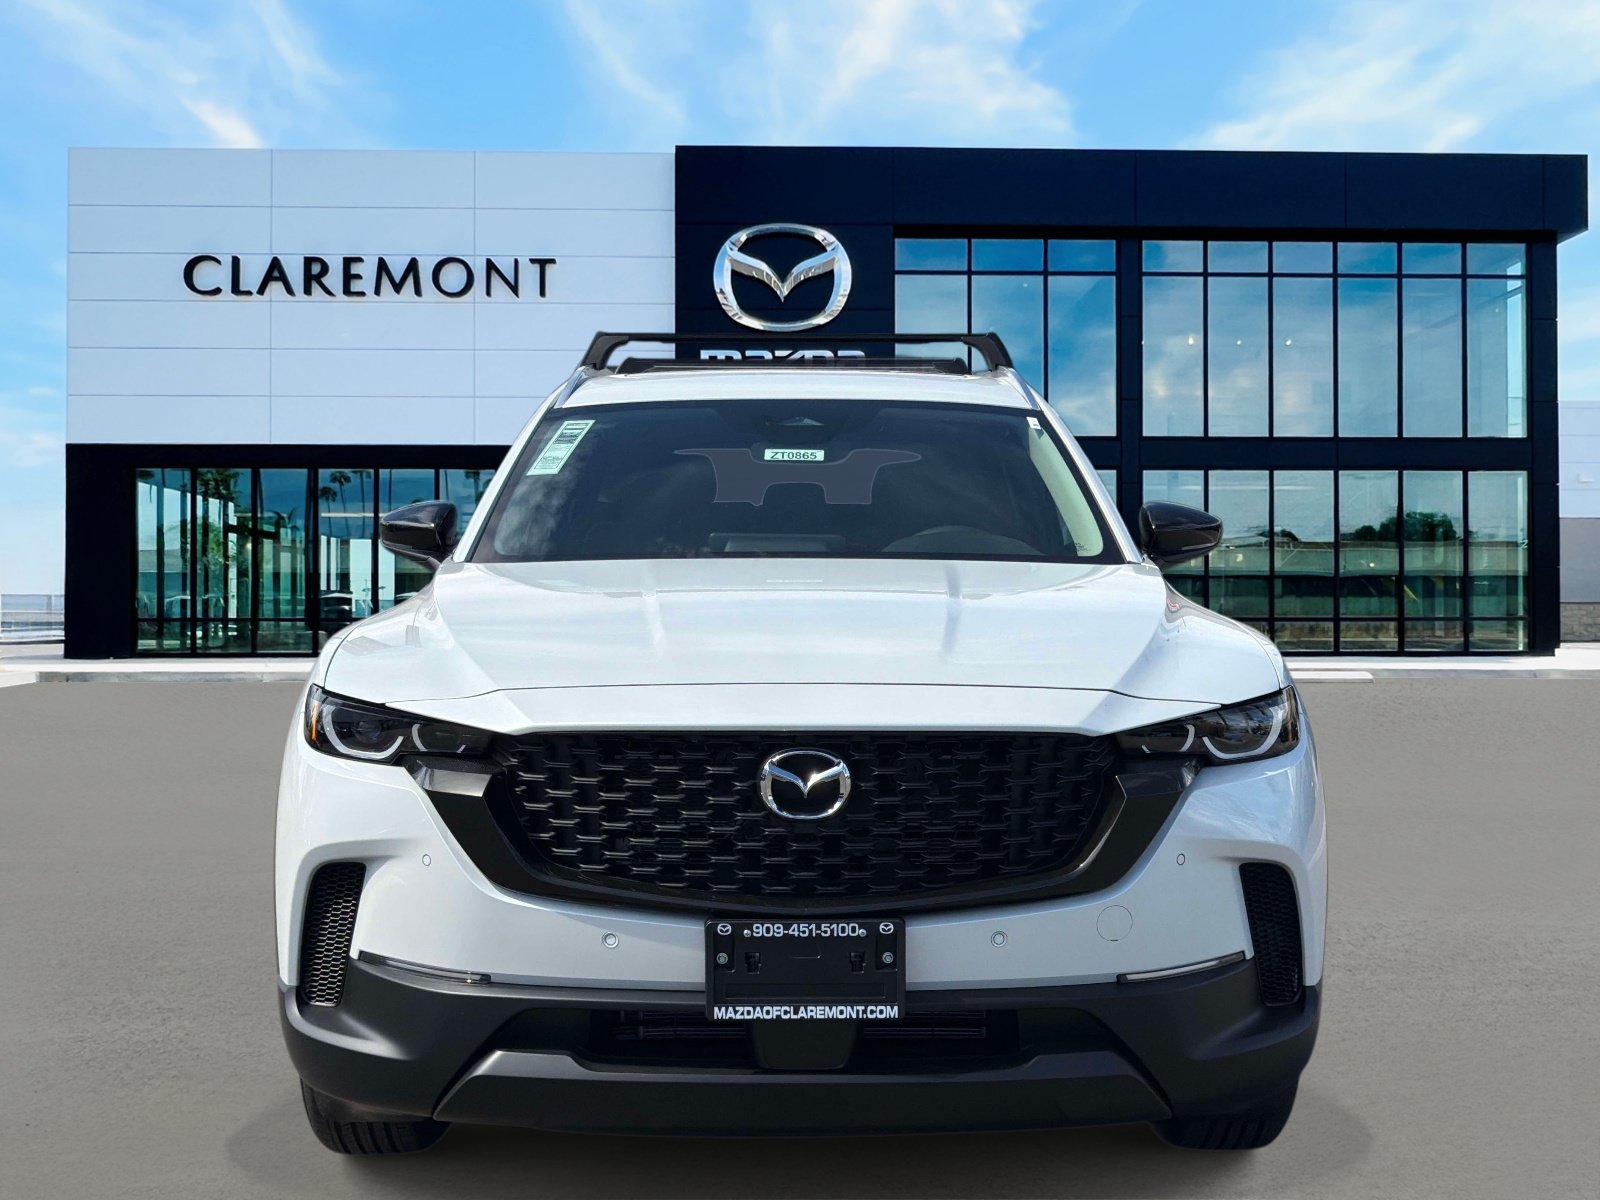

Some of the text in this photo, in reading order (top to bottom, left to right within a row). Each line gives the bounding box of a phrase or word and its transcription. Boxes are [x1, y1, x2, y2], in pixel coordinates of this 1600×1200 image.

[183, 254, 557, 298] CLAREMONT
[770, 451, 818, 460] ZT0865
[752, 923, 859, 937] 909-451-5100
[713, 1005, 899, 1020] MAZDAOFCLAREMONT.COM
